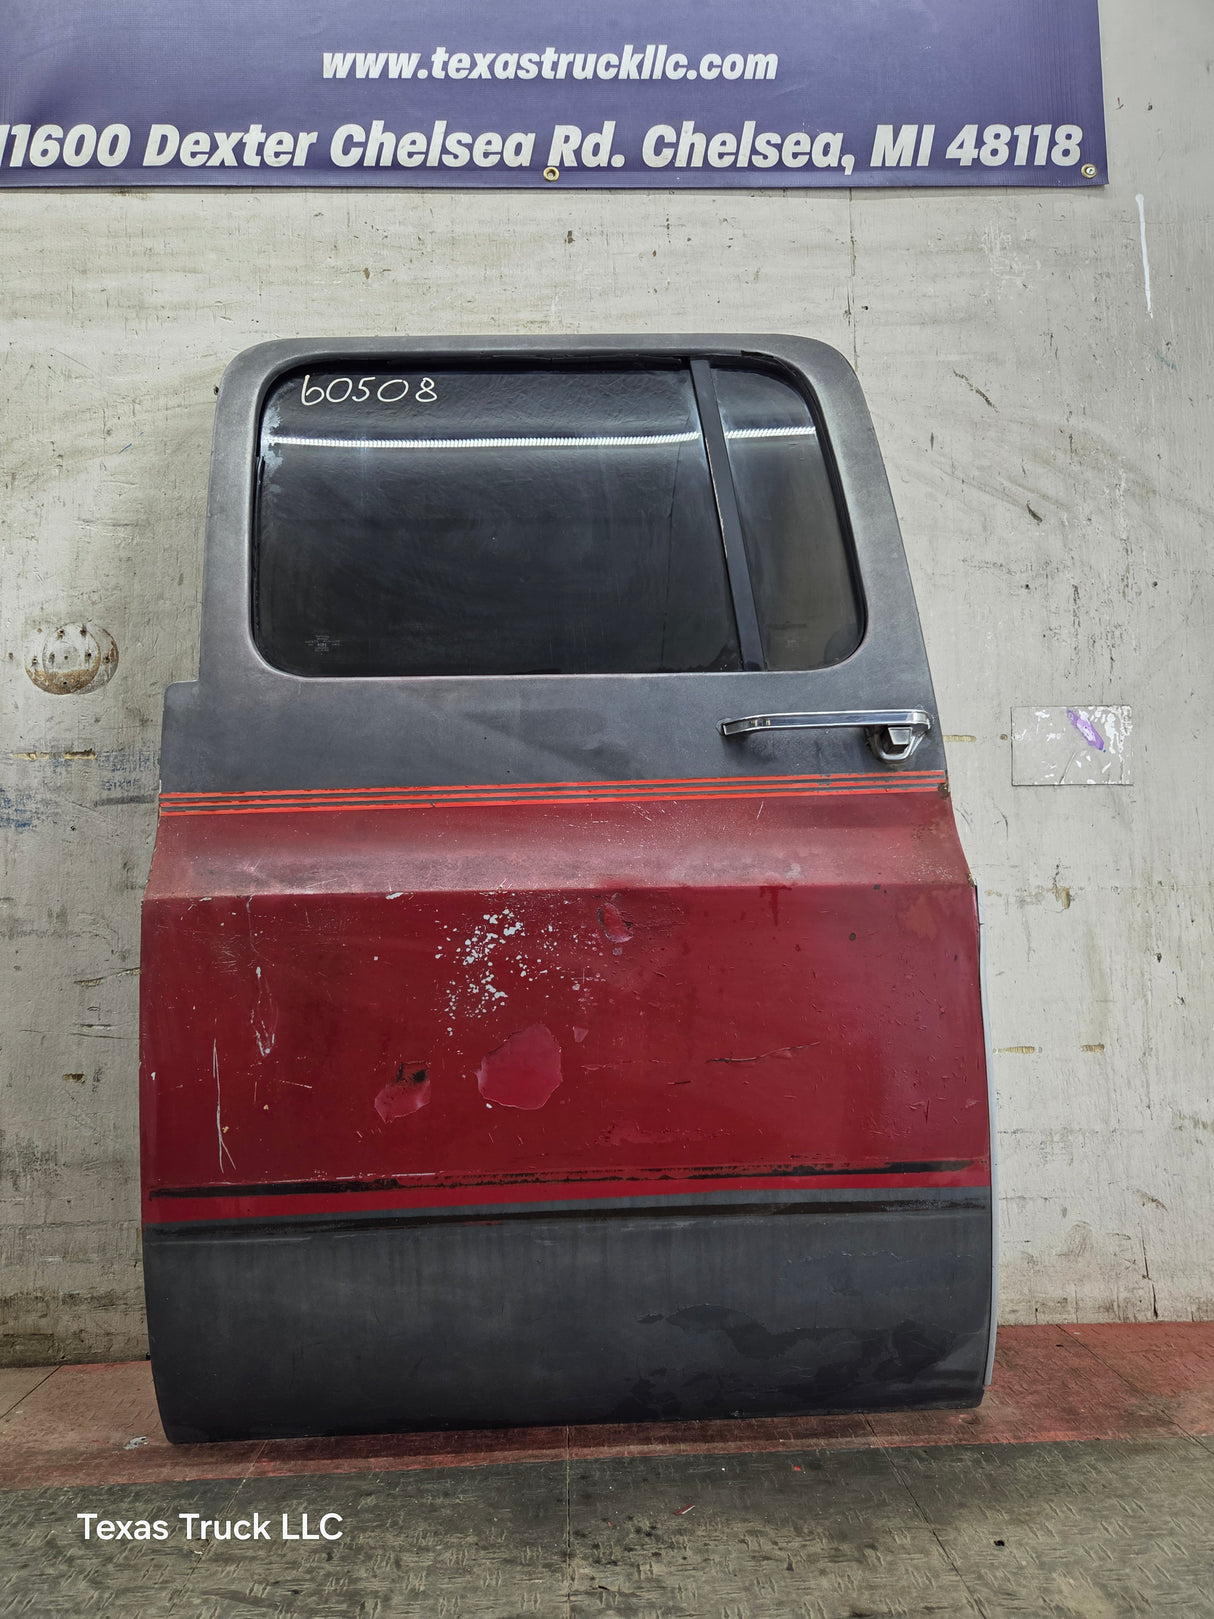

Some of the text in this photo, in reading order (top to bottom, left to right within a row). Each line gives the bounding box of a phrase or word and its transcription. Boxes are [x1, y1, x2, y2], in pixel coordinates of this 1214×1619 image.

[322, 44, 778, 80] www.texastruckllc.com
[142, 124, 318, 168] Dexter
[330, 120, 536, 168] Chelsea
[547, 121, 626, 169] Rd.
[642, 121, 856, 176] Chelsea,
[870, 124, 936, 168] MI
[945, 124, 1083, 167] 48118
[301, 374, 438, 406] 60508
